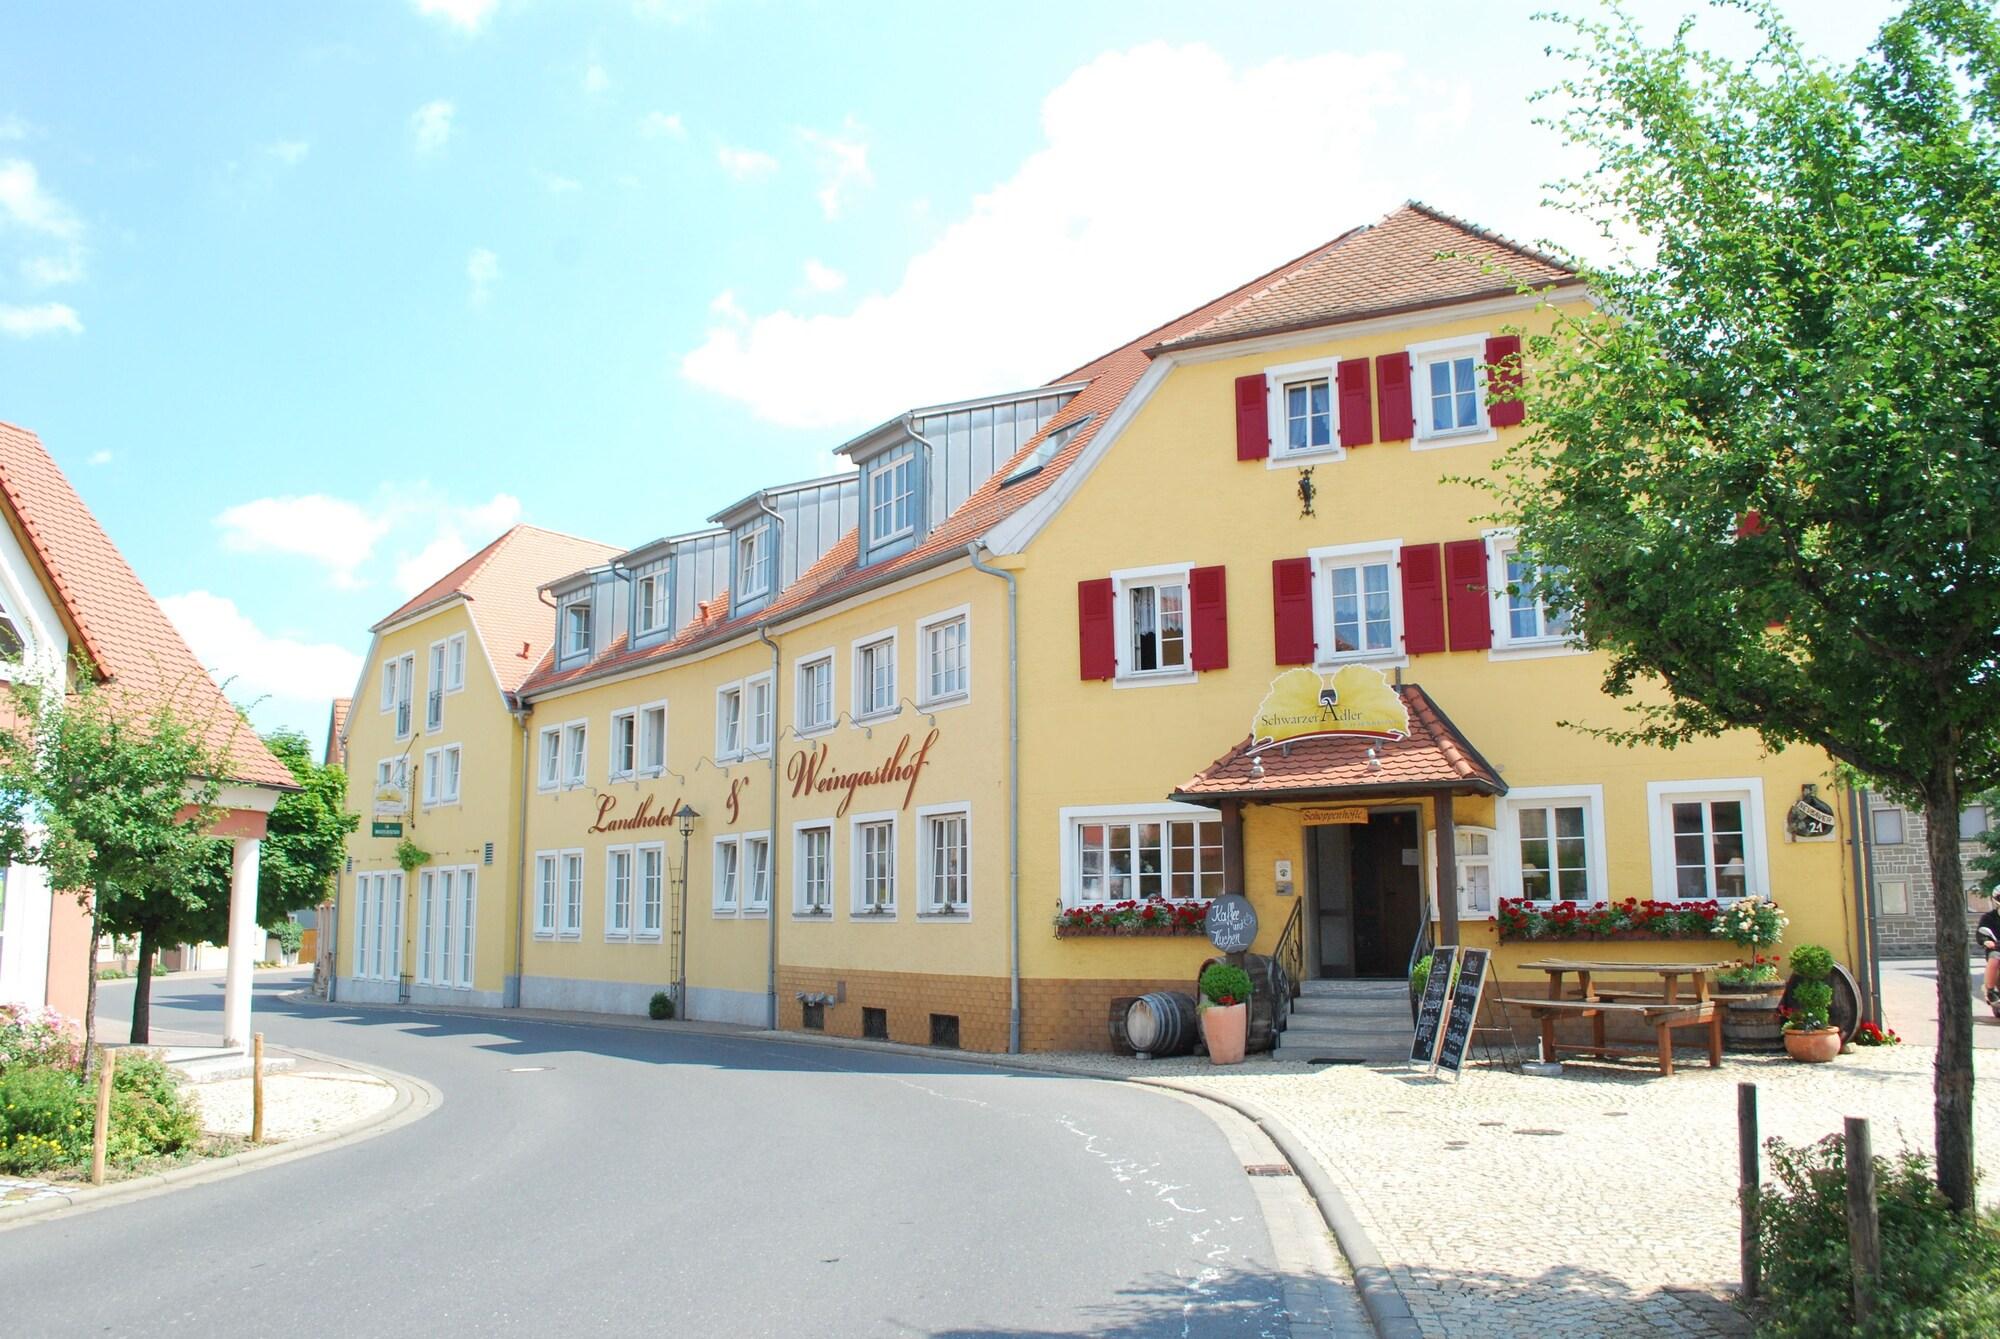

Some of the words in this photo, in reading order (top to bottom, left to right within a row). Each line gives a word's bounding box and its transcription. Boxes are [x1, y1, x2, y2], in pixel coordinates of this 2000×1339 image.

[1261, 713, 1320, 727] Schwarzer
[1320, 699, 1363, 722] Adler
[587, 793, 681, 834] Landhotel
[725, 776, 749, 825] &
[787, 728, 939, 818] Weingasthof
[1809, 822, 1823, 833] 21
[1212, 902, 1239, 926] Kaffee
[1232, 919, 1244, 931] und
[1211, 928, 1240, 946] Kuchen
